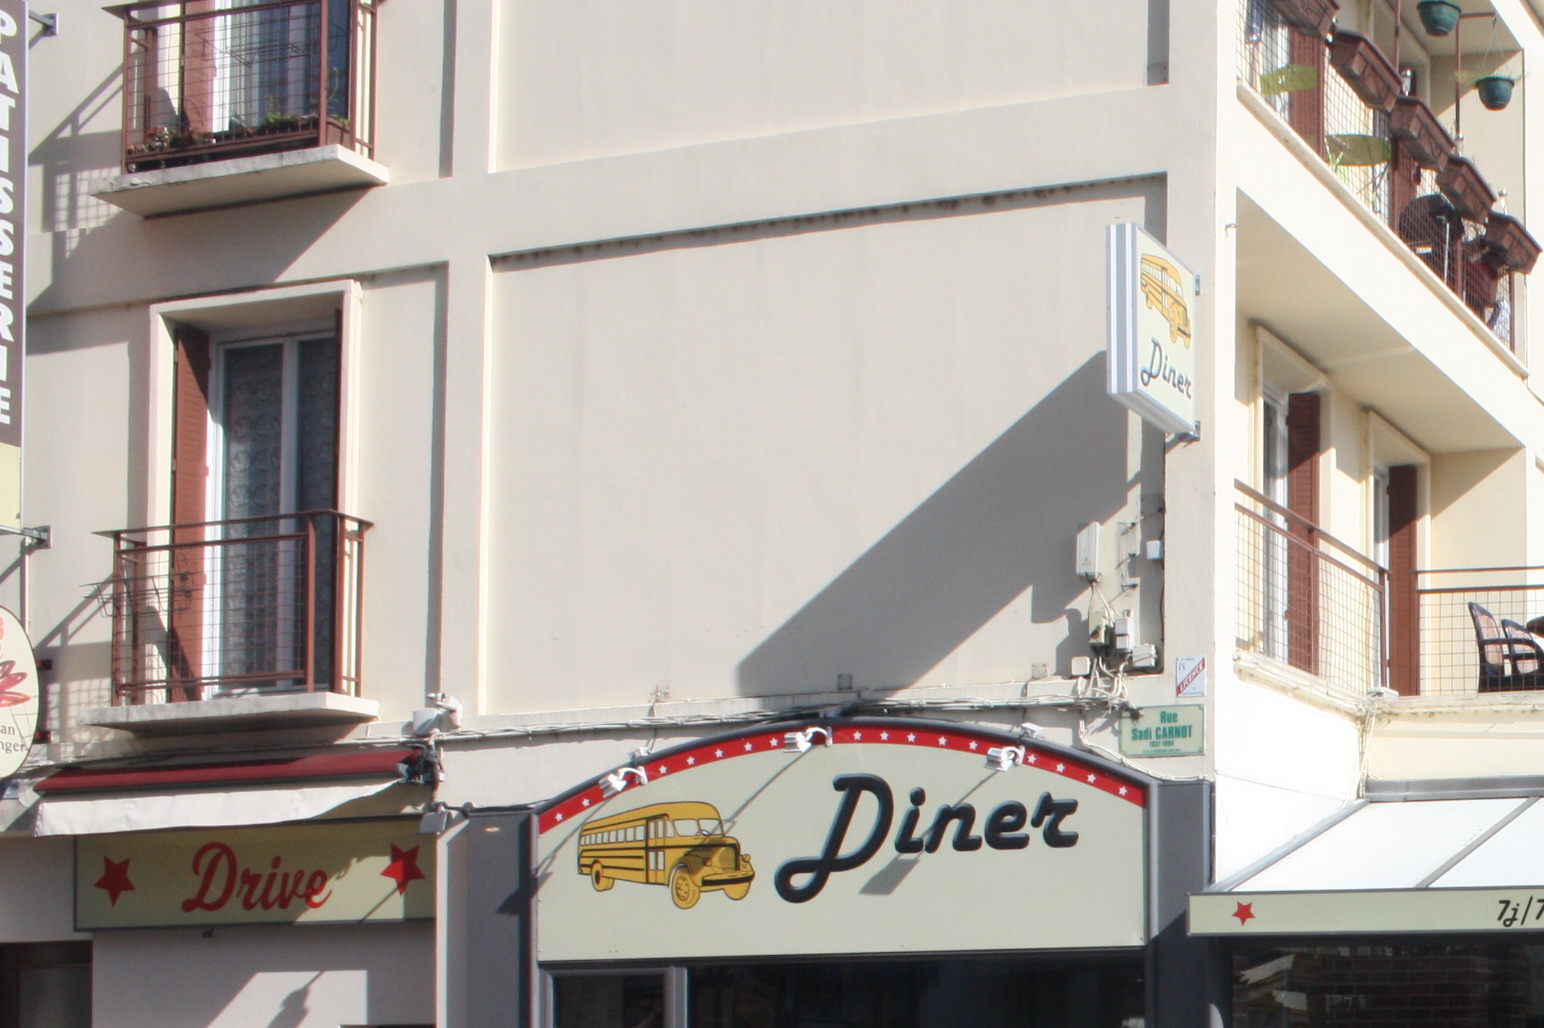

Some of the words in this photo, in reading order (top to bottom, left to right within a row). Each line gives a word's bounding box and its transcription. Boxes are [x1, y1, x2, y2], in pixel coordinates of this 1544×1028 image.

[1140, 336, 1192, 400] Diner
[1131, 727, 1153, 741] Sadi
[1155, 725, 1193, 740] CARNOT
[1160, 711, 1178, 723] Rue
[774, 773, 1079, 904] Diner
[181, 841, 333, 913] Drive
